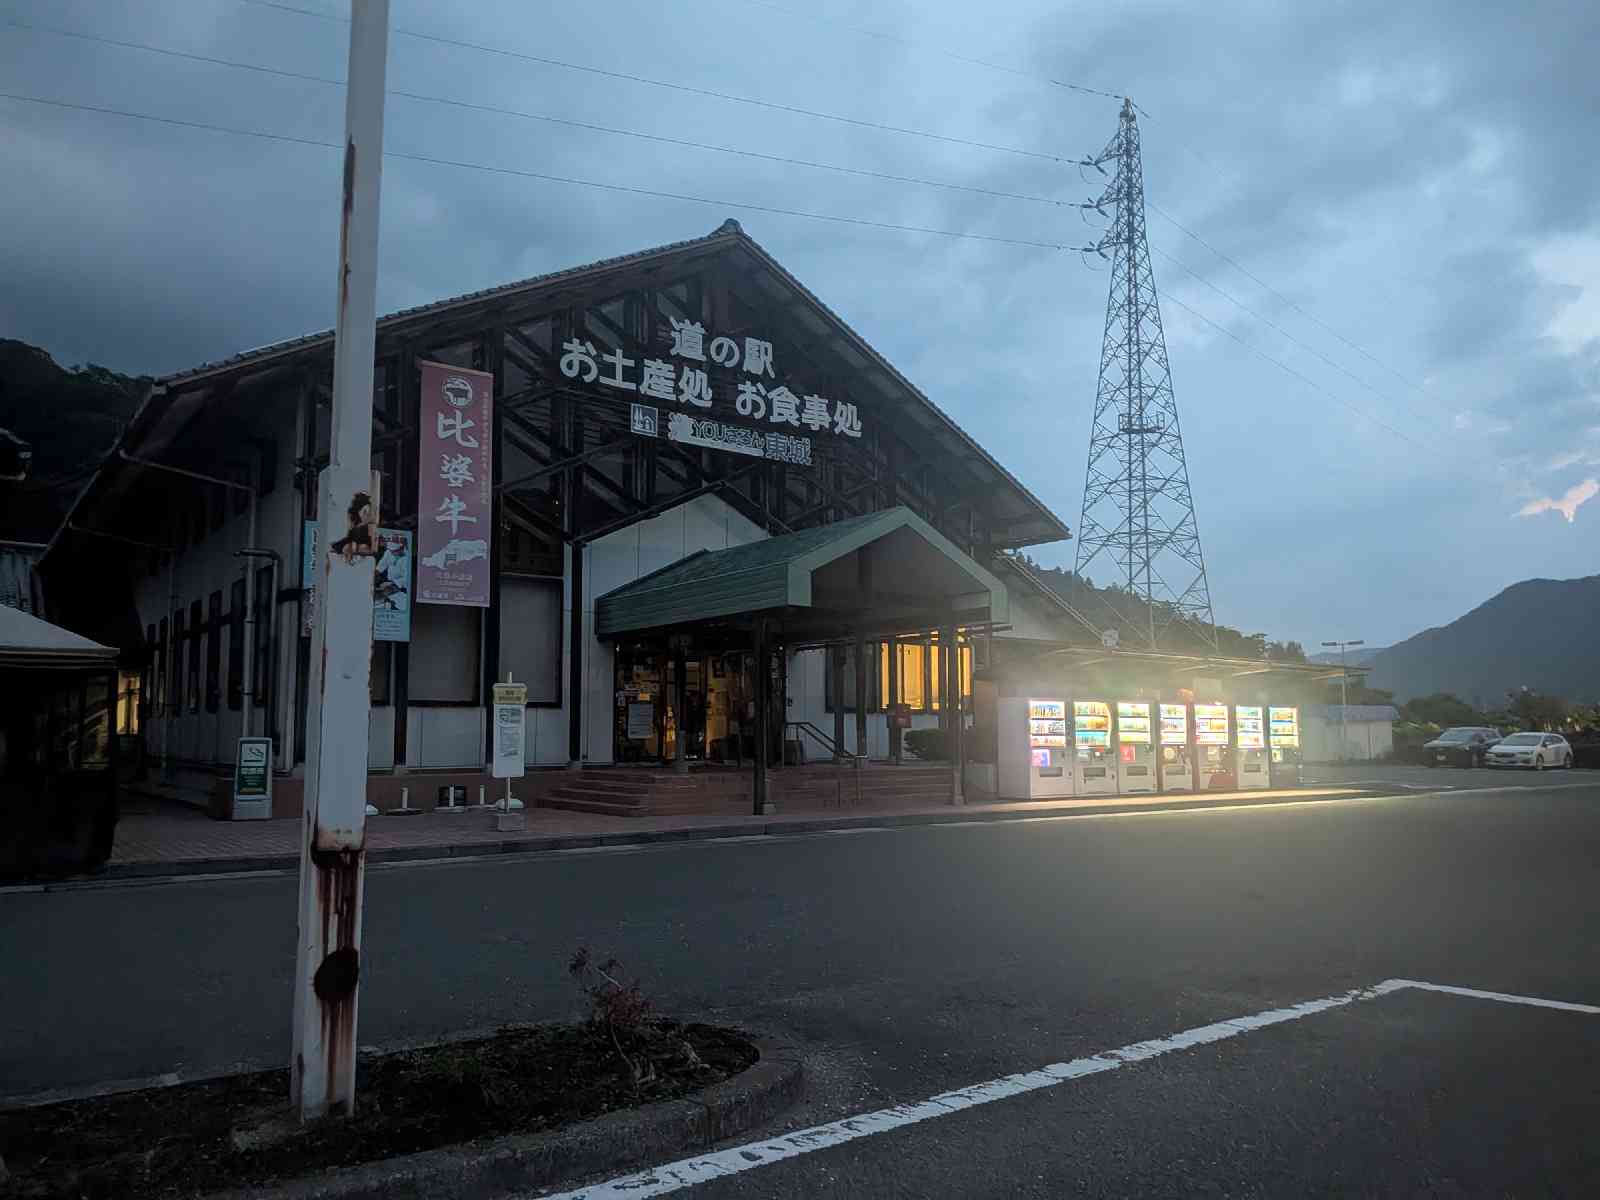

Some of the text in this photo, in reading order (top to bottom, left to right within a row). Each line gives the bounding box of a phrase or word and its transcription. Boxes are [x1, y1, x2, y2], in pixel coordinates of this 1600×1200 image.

[559, 338, 863, 438] お土産処 お食事処
[670, 316, 776, 378] 道の駅
[437, 409, 479, 537] 比婆牛
